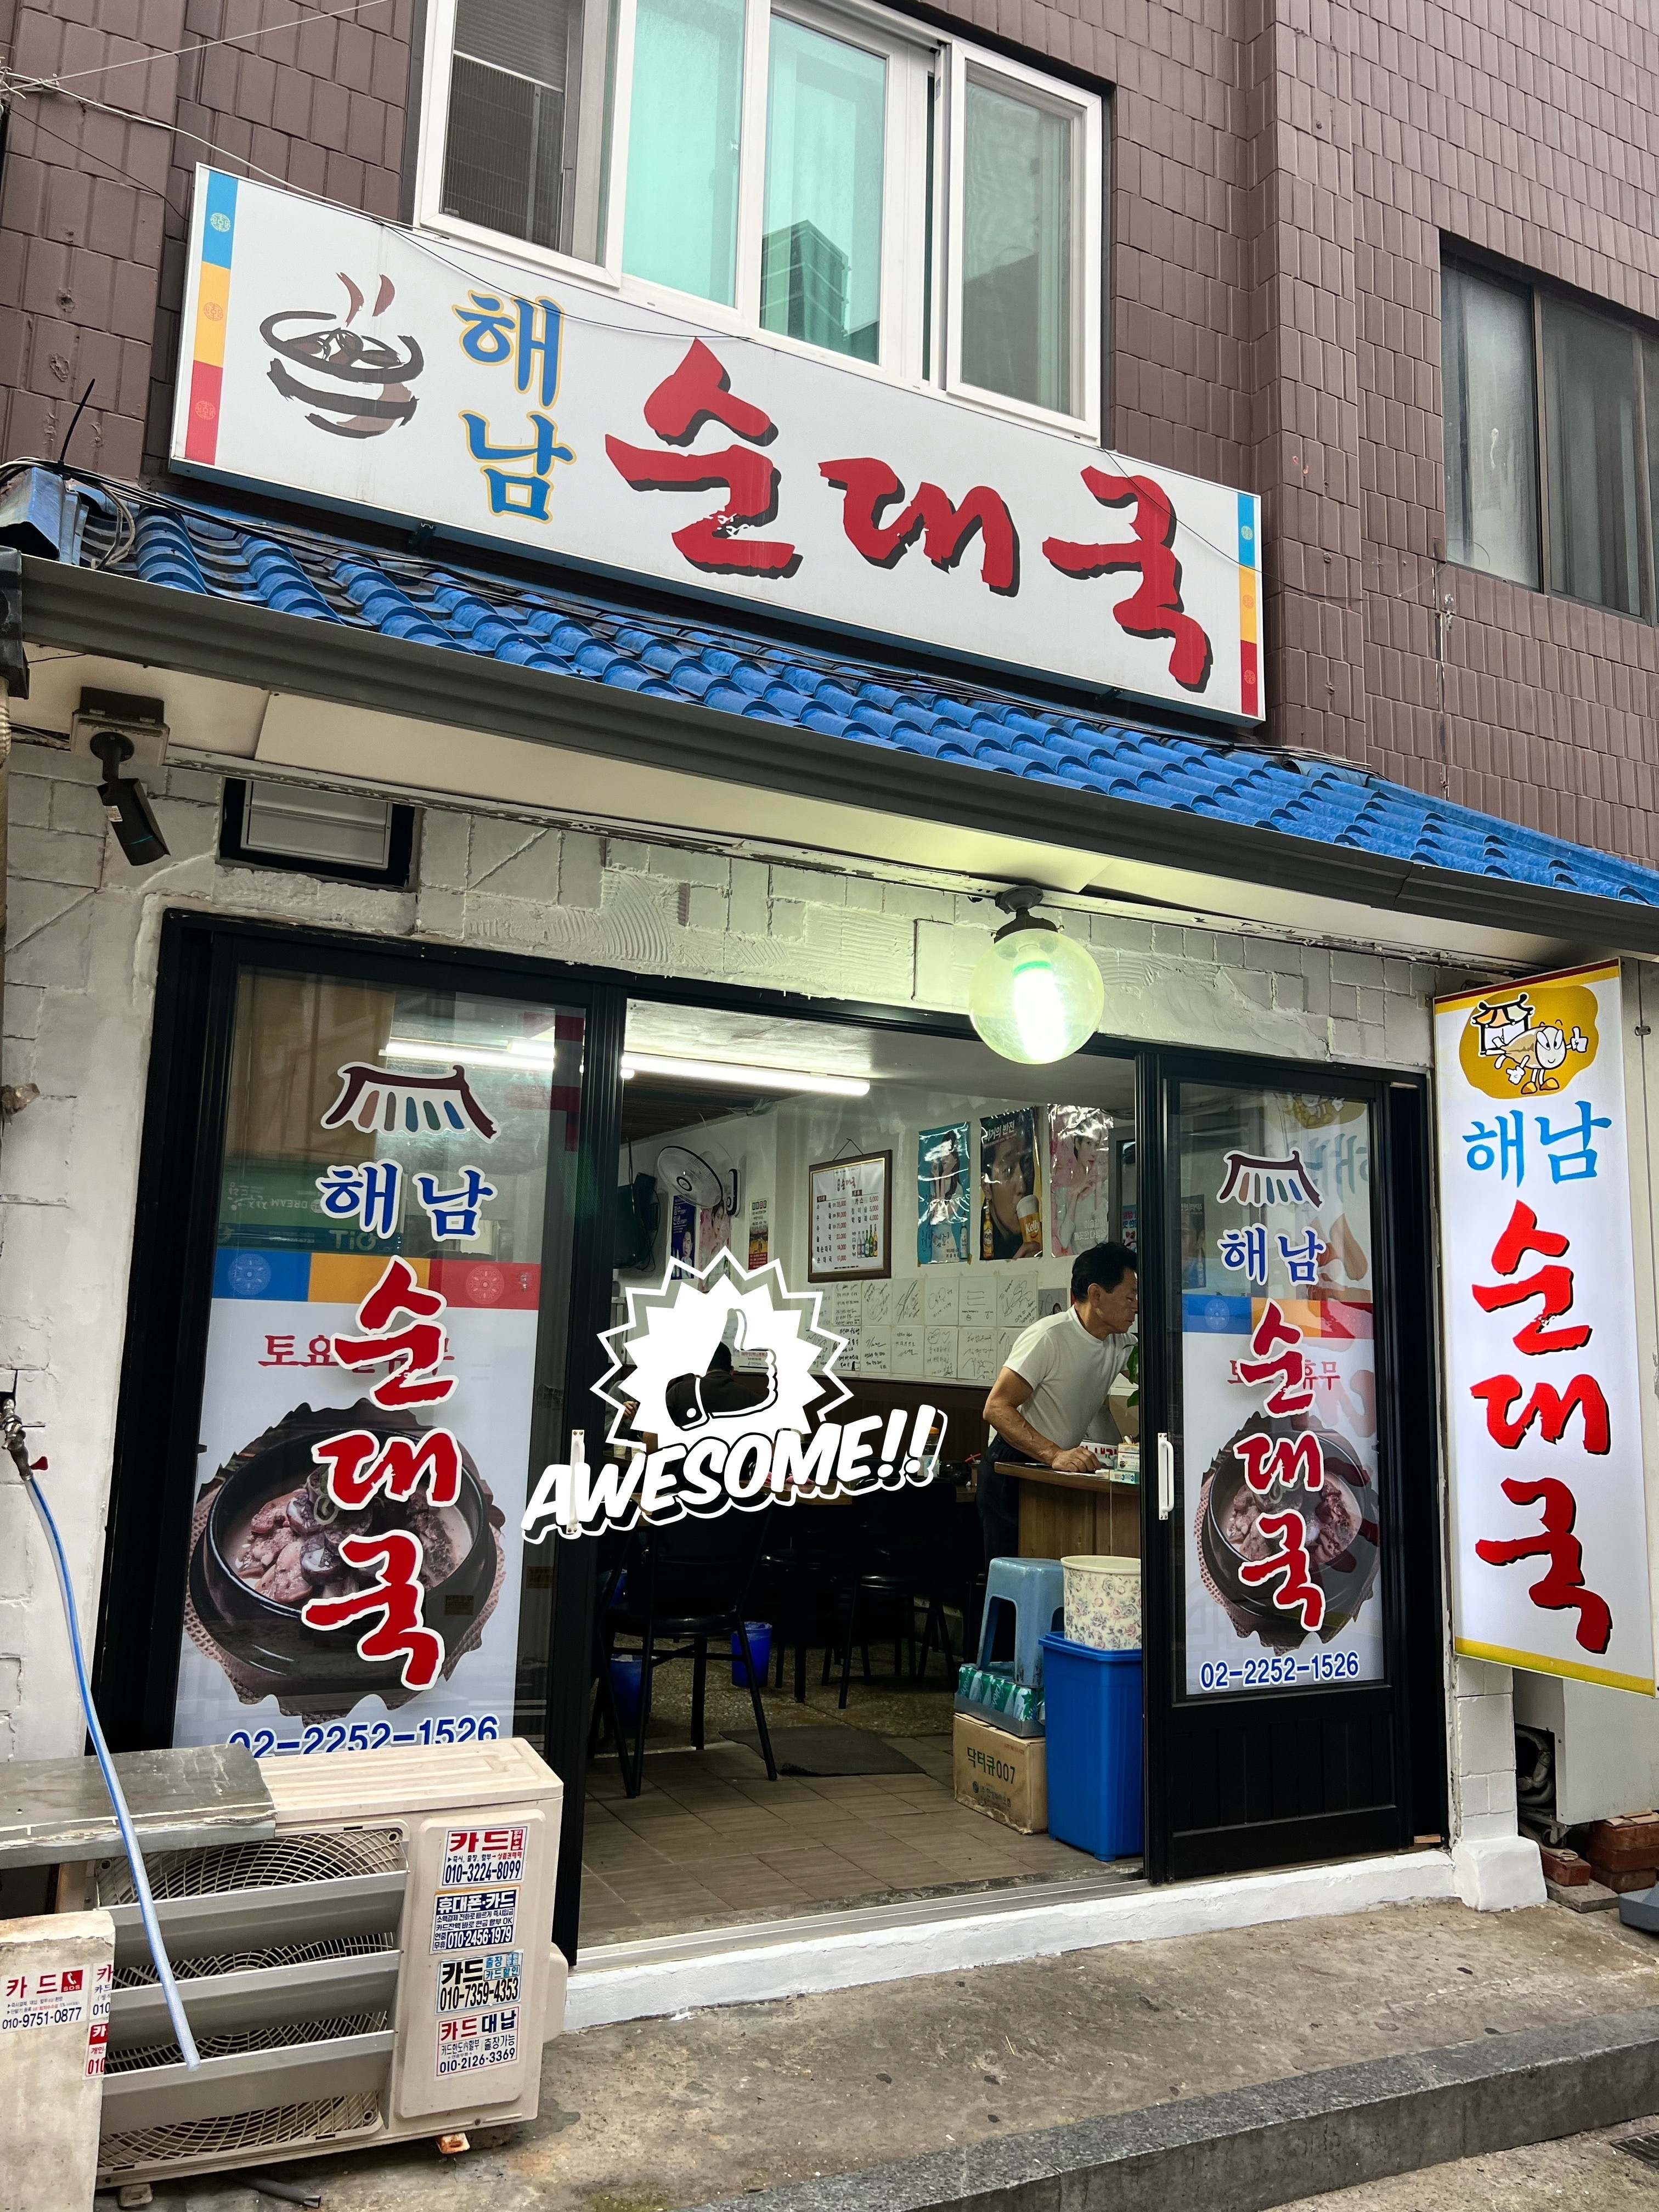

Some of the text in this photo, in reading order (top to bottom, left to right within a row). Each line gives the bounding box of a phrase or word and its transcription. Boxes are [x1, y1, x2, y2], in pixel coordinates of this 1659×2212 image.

[452, 290, 576, 524] 해남
[605, 337, 1213, 693] 순대국
[1002, 1120, 1015, 1136] 반전
[1462, 1101, 1612, 1188] 해남
[316, 1159, 498, 1242] 해남
[1026, 1220, 1039, 1234] Kelly
[1217, 1222, 1327, 1286] 해남
[1470, 1199, 1612, 1654] 순대국
[301, 1255, 462, 1690] 순대국
[1233, 1298, 1326, 1630] 순대국
[1200, 1651, 1359, 1690] 02-2252-1526
[967, 1747, 1015, 1784] 닥터큐007
[449, 1830, 509, 1853] 카드
[445, 1860, 521, 1883] 010-3224-8099
[436, 1922, 461, 1932] 카드잔액
[462, 1921, 475, 1929] 바로
[476, 1920, 488, 1928] 현금
[459, 1912, 476, 1921] 전화로
[441, 1959, 484, 1985] 카드
[486, 1955, 502, 1968] 출장
[486, 1966, 518, 1979] 카드할인
[6, 1974, 58, 1999] 카드
[440, 1977, 519, 2011] 010-7359-4353
[2, 2007, 82, 2029] 010-9751-0877
[441, 2010, 517, 2041] 카드 대납
[484, 2034, 515, 2051] 출장가능
